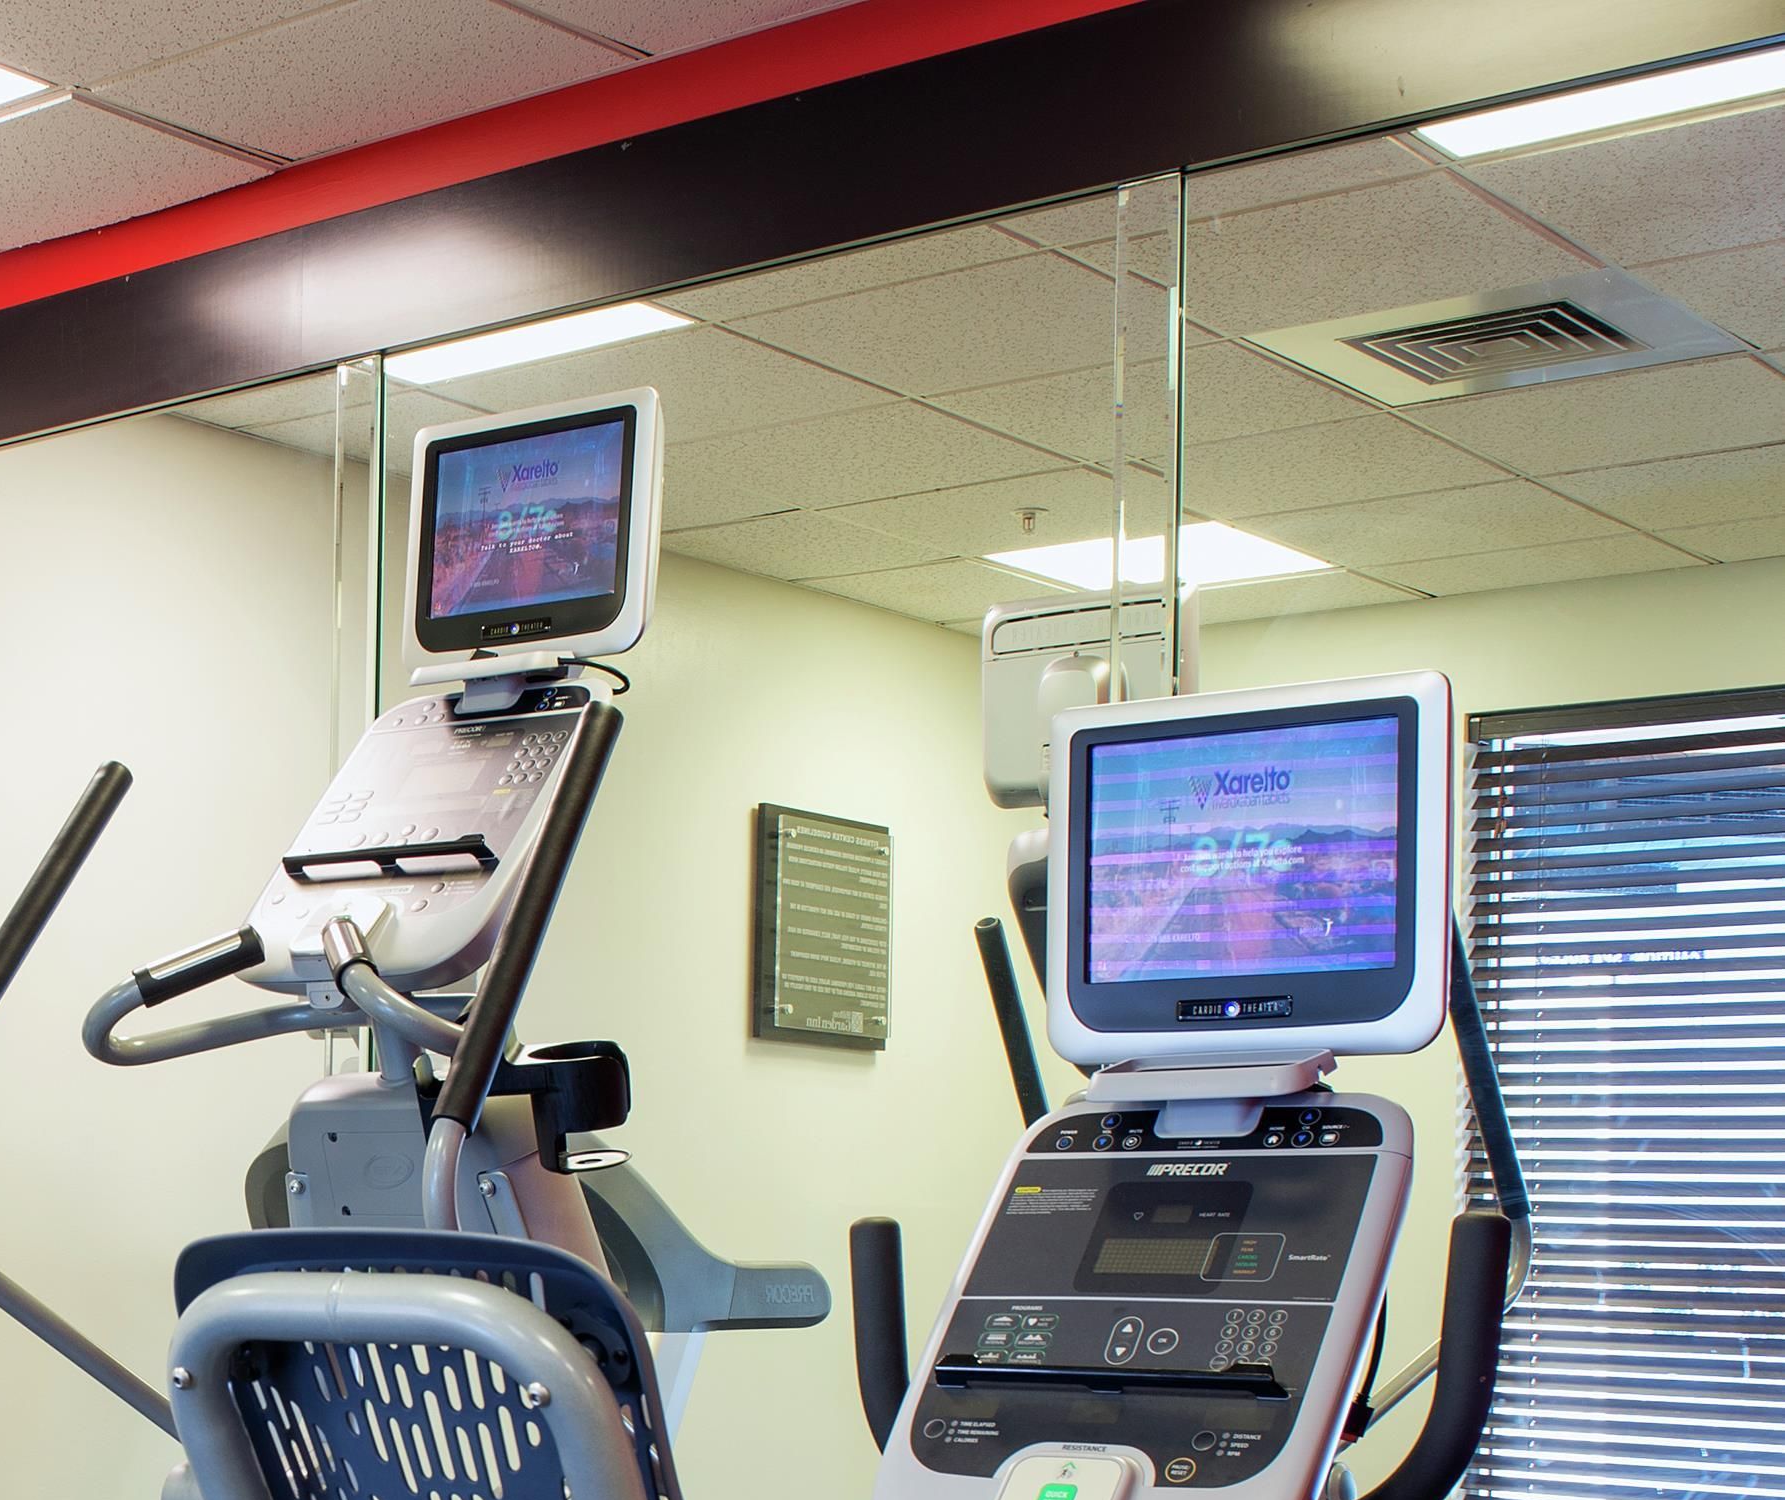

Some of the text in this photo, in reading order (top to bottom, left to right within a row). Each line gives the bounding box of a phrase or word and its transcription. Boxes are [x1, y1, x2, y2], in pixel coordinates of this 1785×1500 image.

[512, 460, 558, 482] Xarelto
[1214, 766, 1291, 796] Xarelto
[1192, 1002, 1279, 1015] CARDIO THEATER
[1157, 1163, 1227, 1177] PRECOR
[1062, 1444, 1107, 1452] RESISTANCE
[1045, 1491, 1068, 1499] QUICK
